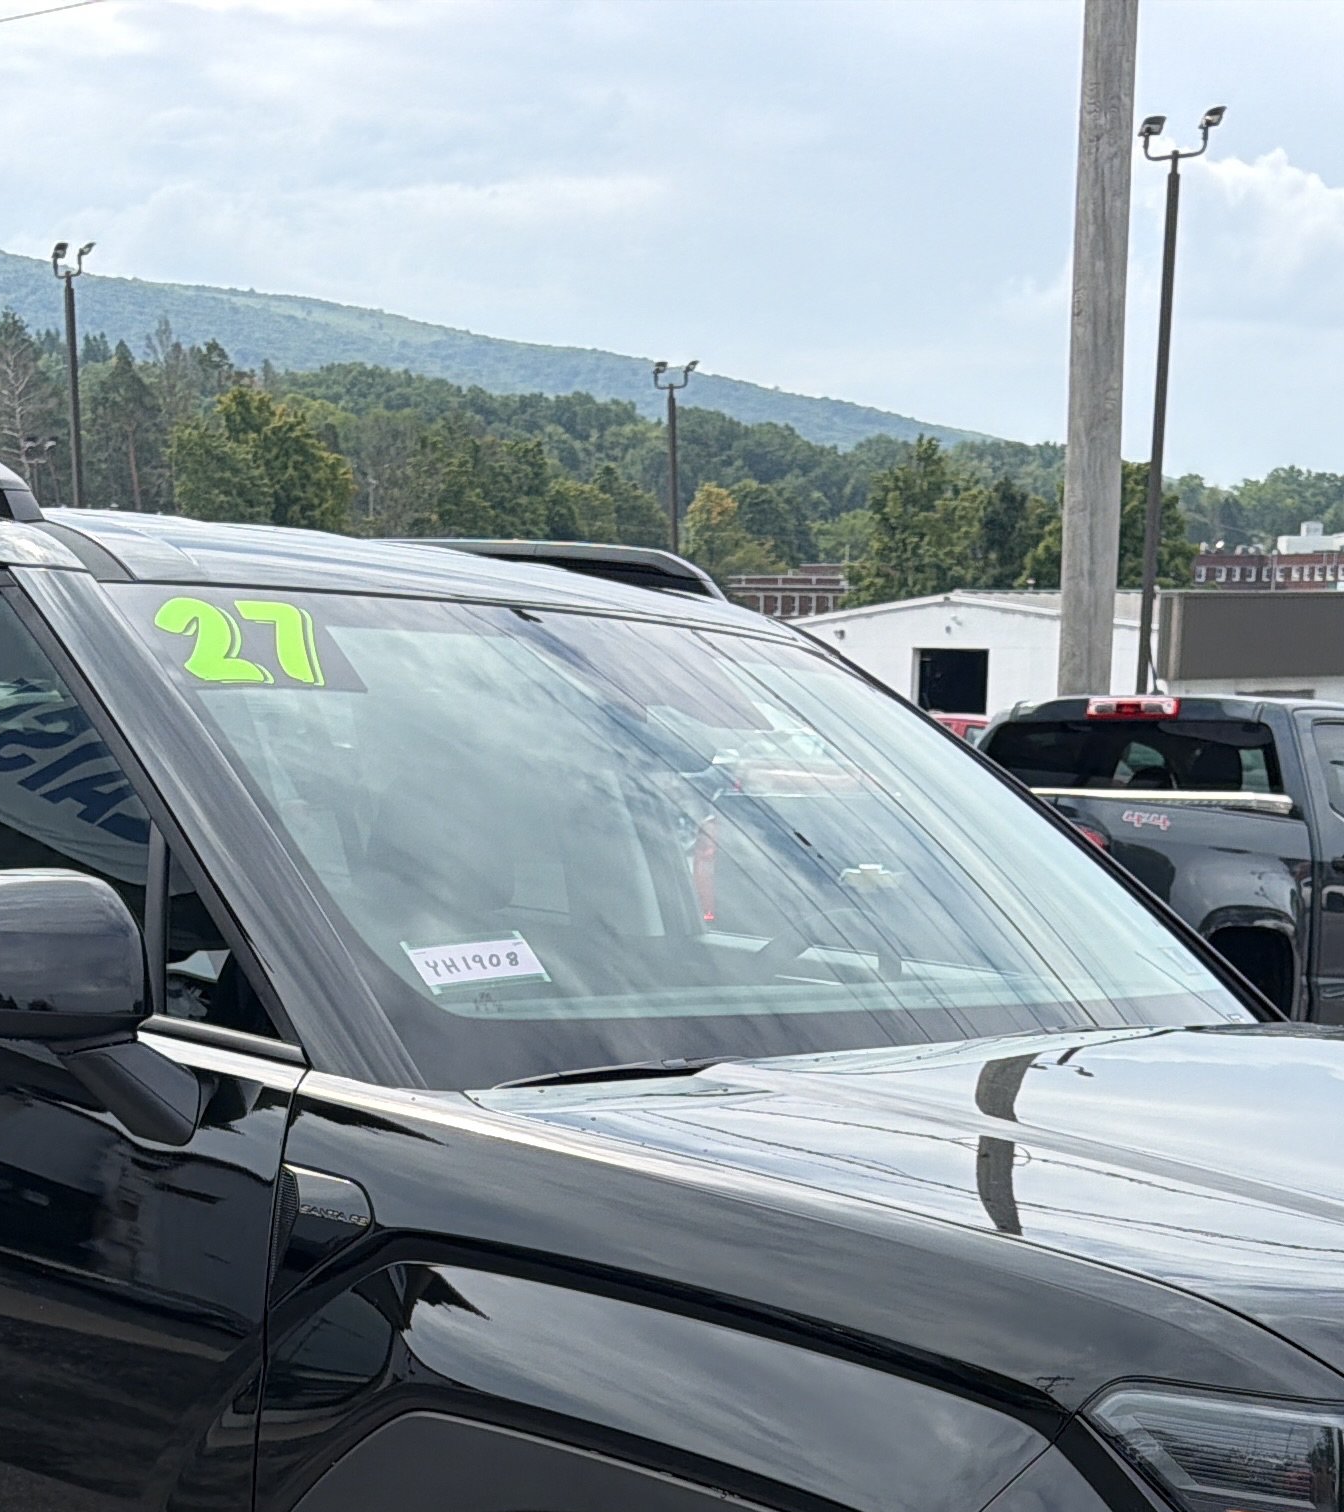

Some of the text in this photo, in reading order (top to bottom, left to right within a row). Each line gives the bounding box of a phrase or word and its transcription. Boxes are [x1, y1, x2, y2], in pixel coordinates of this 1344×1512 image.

[154, 597, 325, 687] 27
[424, 951, 520, 978] YH1908
[300, 1204, 348, 1222] SANTA
